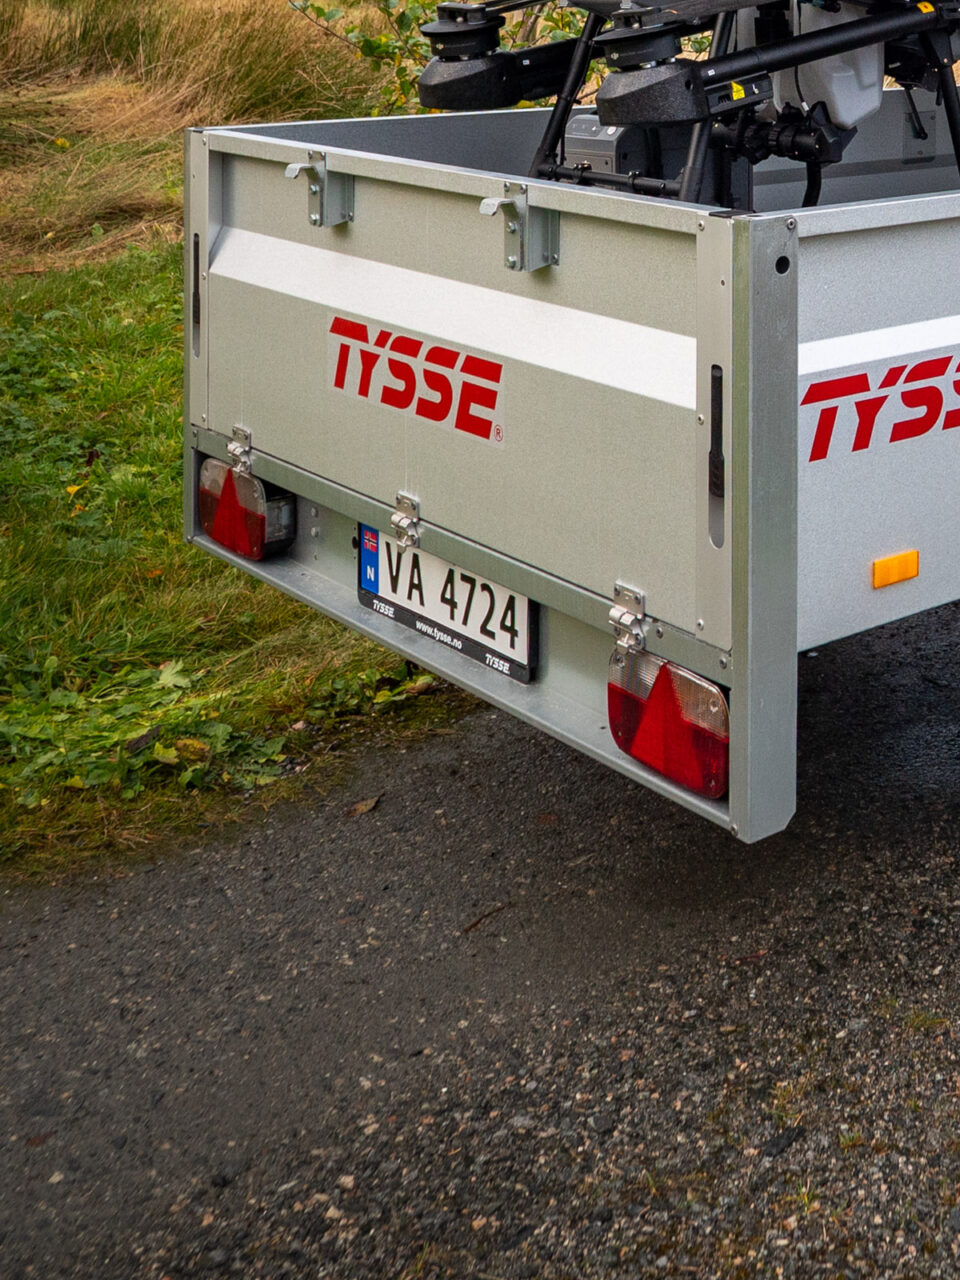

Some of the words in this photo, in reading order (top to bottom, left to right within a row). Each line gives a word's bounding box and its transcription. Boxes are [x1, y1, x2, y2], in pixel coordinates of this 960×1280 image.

[329, 316, 503, 441] TYSSE
[366, 565, 375, 582] N
[372, 599, 395, 618] TYSSE
[385, 541, 425, 607] VA
[440, 567, 519, 650] 4724
[415, 620, 463, 650] www.tysse.no
[485, 652, 510, 675] TYSSE
